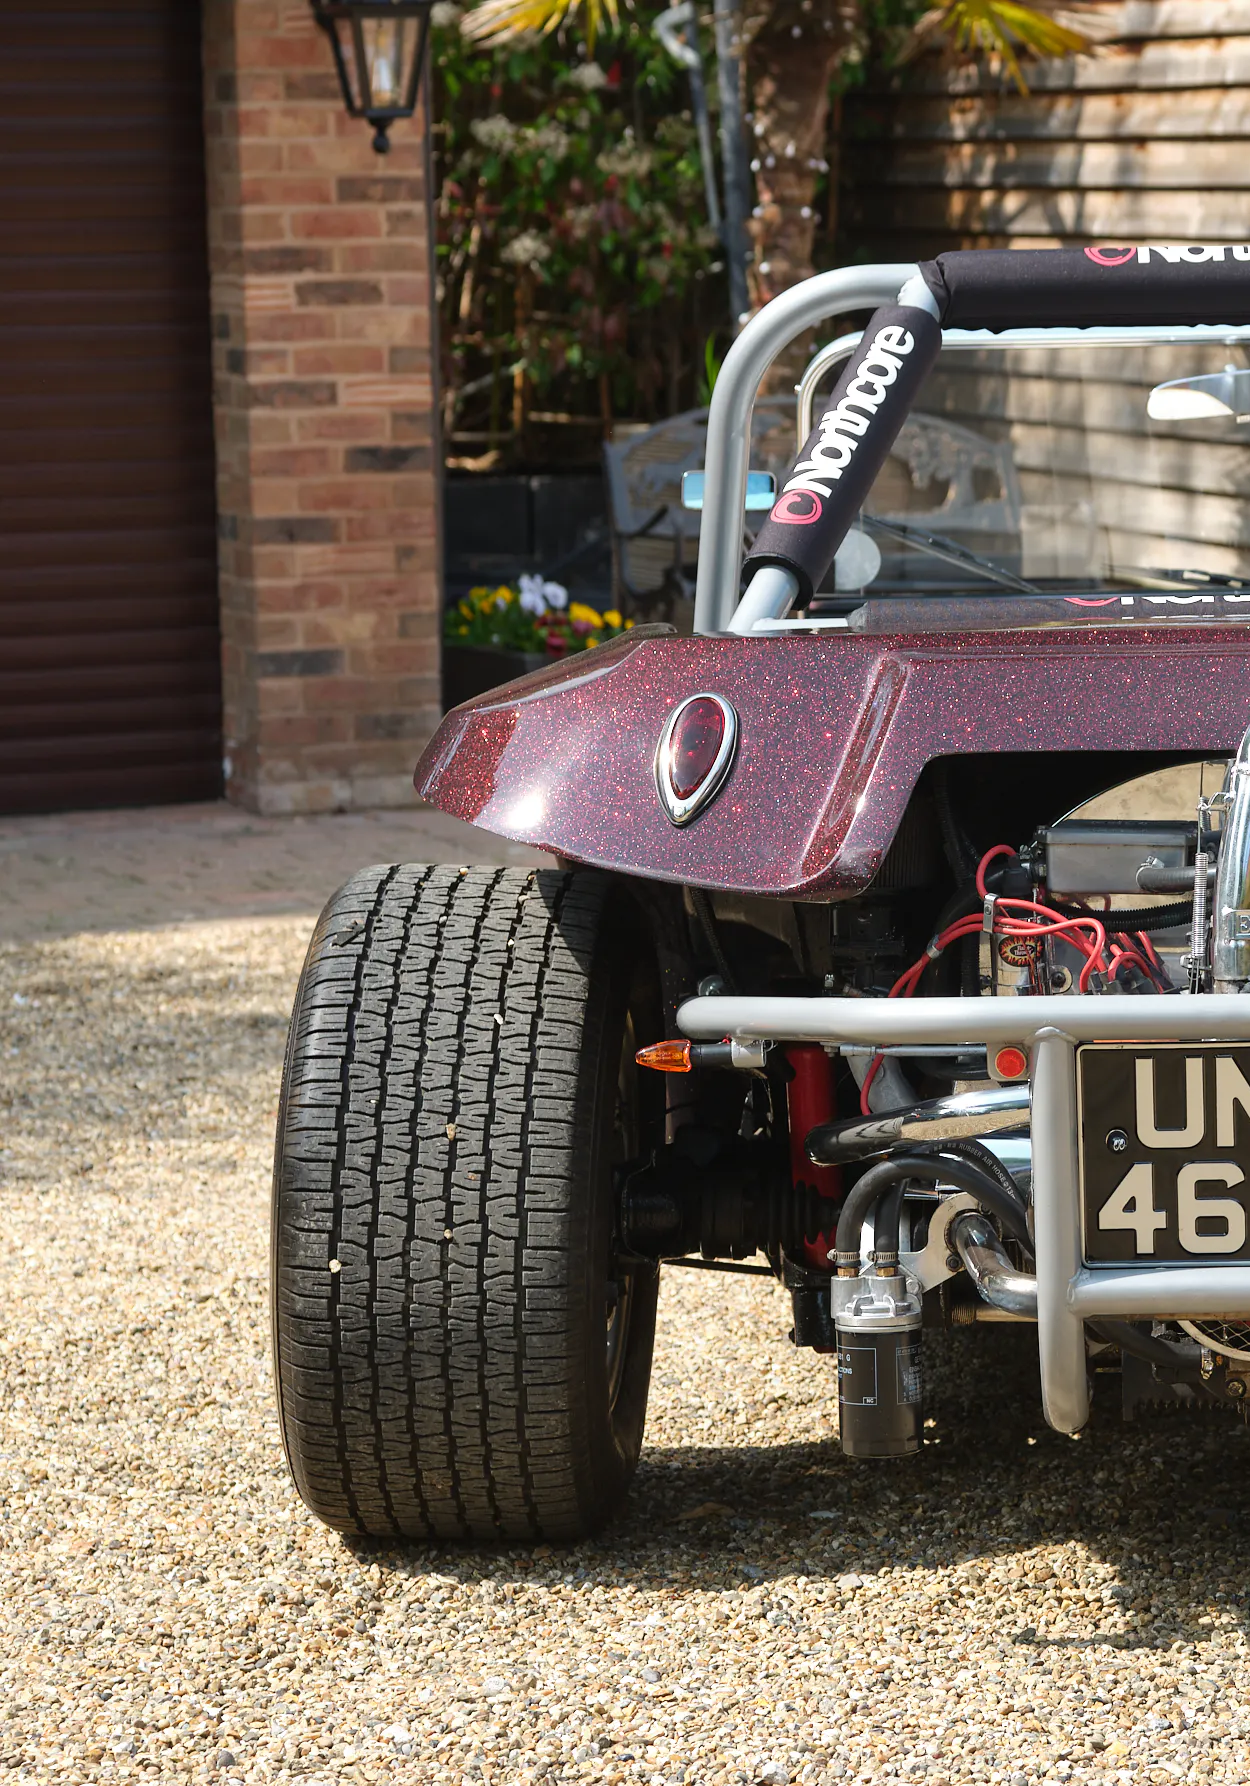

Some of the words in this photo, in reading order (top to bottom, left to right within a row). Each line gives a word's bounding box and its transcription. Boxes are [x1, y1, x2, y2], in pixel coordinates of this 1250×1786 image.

[783, 325, 915, 498] Northcore
[958, 1143, 982, 1157] RUBBER
[981, 1156, 993, 1167] AIR
[991, 1164, 1007, 1183] HOSE
